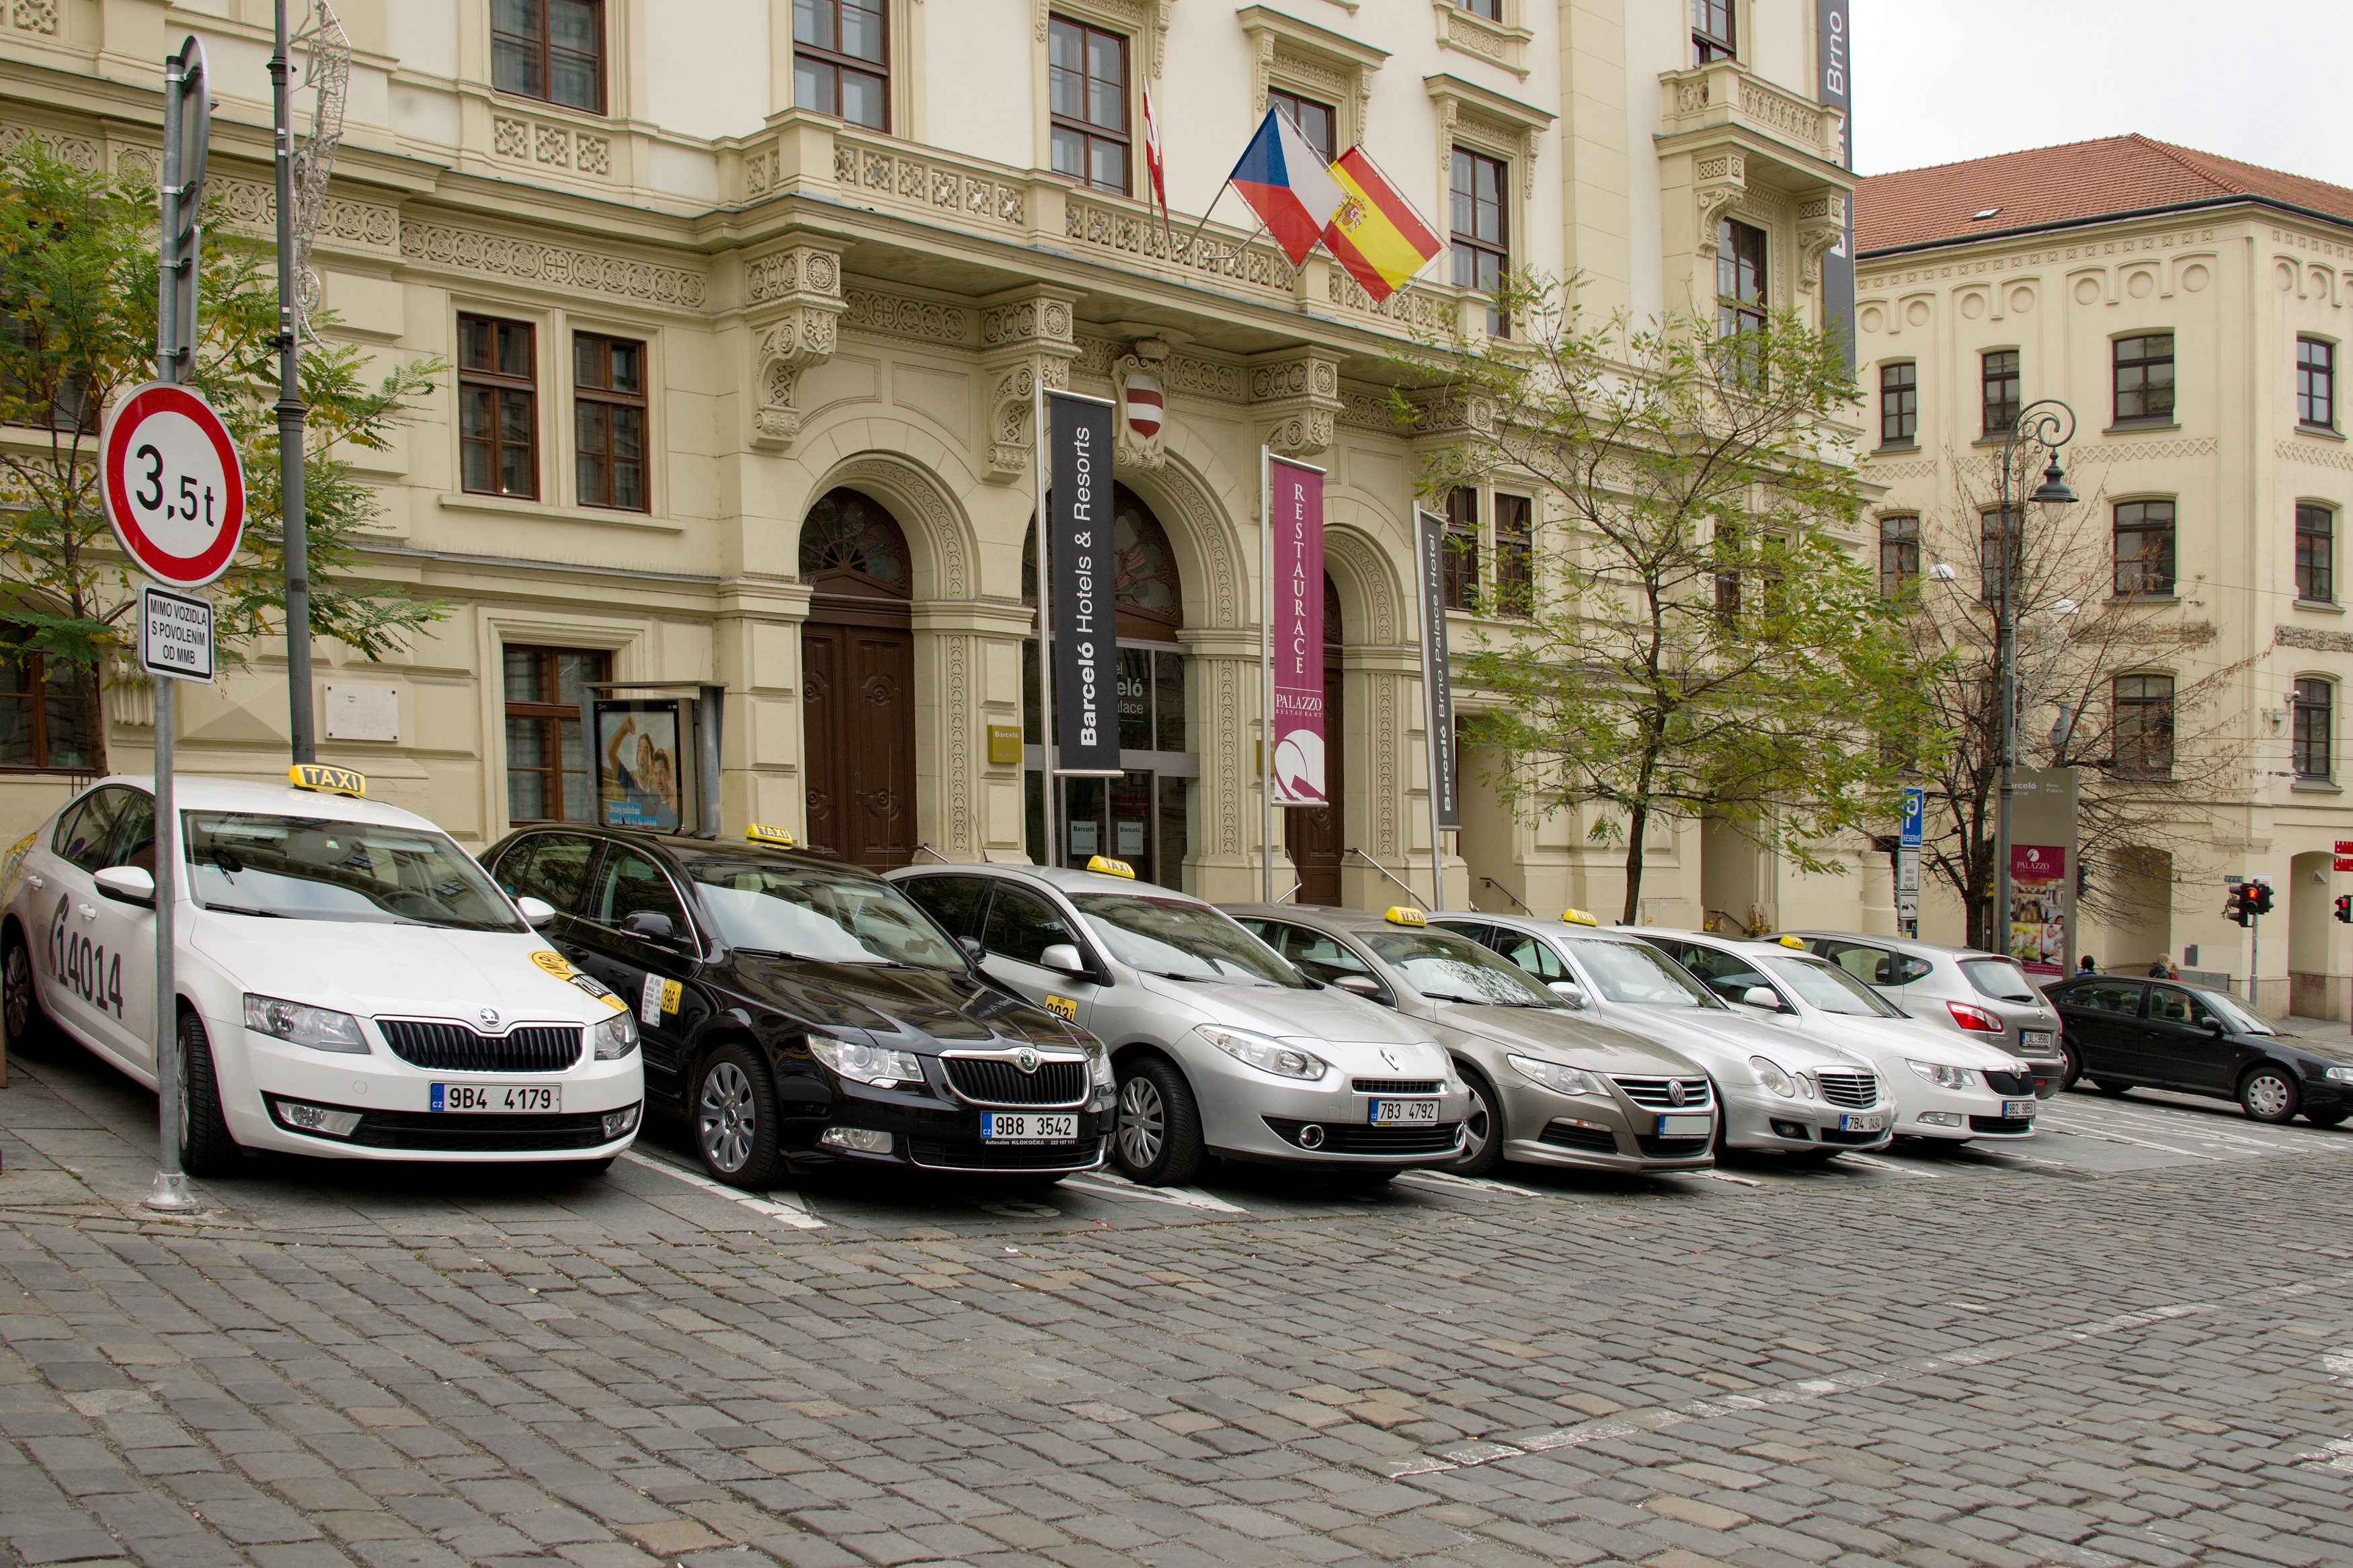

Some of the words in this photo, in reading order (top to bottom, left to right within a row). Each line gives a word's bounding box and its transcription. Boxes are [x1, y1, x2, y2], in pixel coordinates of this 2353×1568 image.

[1827, 11, 1843, 96] Brno
[1074, 426, 1090, 521] Resorts
[1075, 531, 1091, 548] &
[1428, 534, 1437, 586] Hotel
[1293, 483, 1306, 674] RESTAURACE
[1076, 555, 1093, 633] Hotels
[151, 598, 172, 617] MIMO
[174, 604, 206, 626] VOZIDLA
[152, 621, 157, 635] S
[159, 622, 205, 646] POVOLENÍM
[1433, 594, 1442, 663] Palace
[163, 645, 175, 660] OD
[177, 648, 196, 664] MMB
[1077, 642, 1097, 746] Barceló
[1276, 694, 1322, 710] PALAZZO
[1118, 700, 1144, 714] lace
[1276, 709, 1322, 718] RESTAURANT
[1439, 725, 1451, 812] Barceló
[306, 768, 358, 791] TAXI
[758, 825, 788, 838] TAXI
[1104, 860, 1130, 873] TAXI
[2017, 862, 2049, 870] PALAZZO
[1401, 911, 1423, 923] TAXI
[1577, 911, 1595, 922] TAXI
[57, 925, 123, 1020] 14014
[450, 1087, 487, 1109] 9B4
[504, 1089, 551, 1109] 4179
[1380, 1103, 1401, 1119] 7B3
[1408, 1103, 1433, 1119] 4792
[996, 1116, 1025, 1135] 9B8
[1037, 1117, 1071, 1135] 3542
[1849, 1117, 1864, 1129] 7B4
